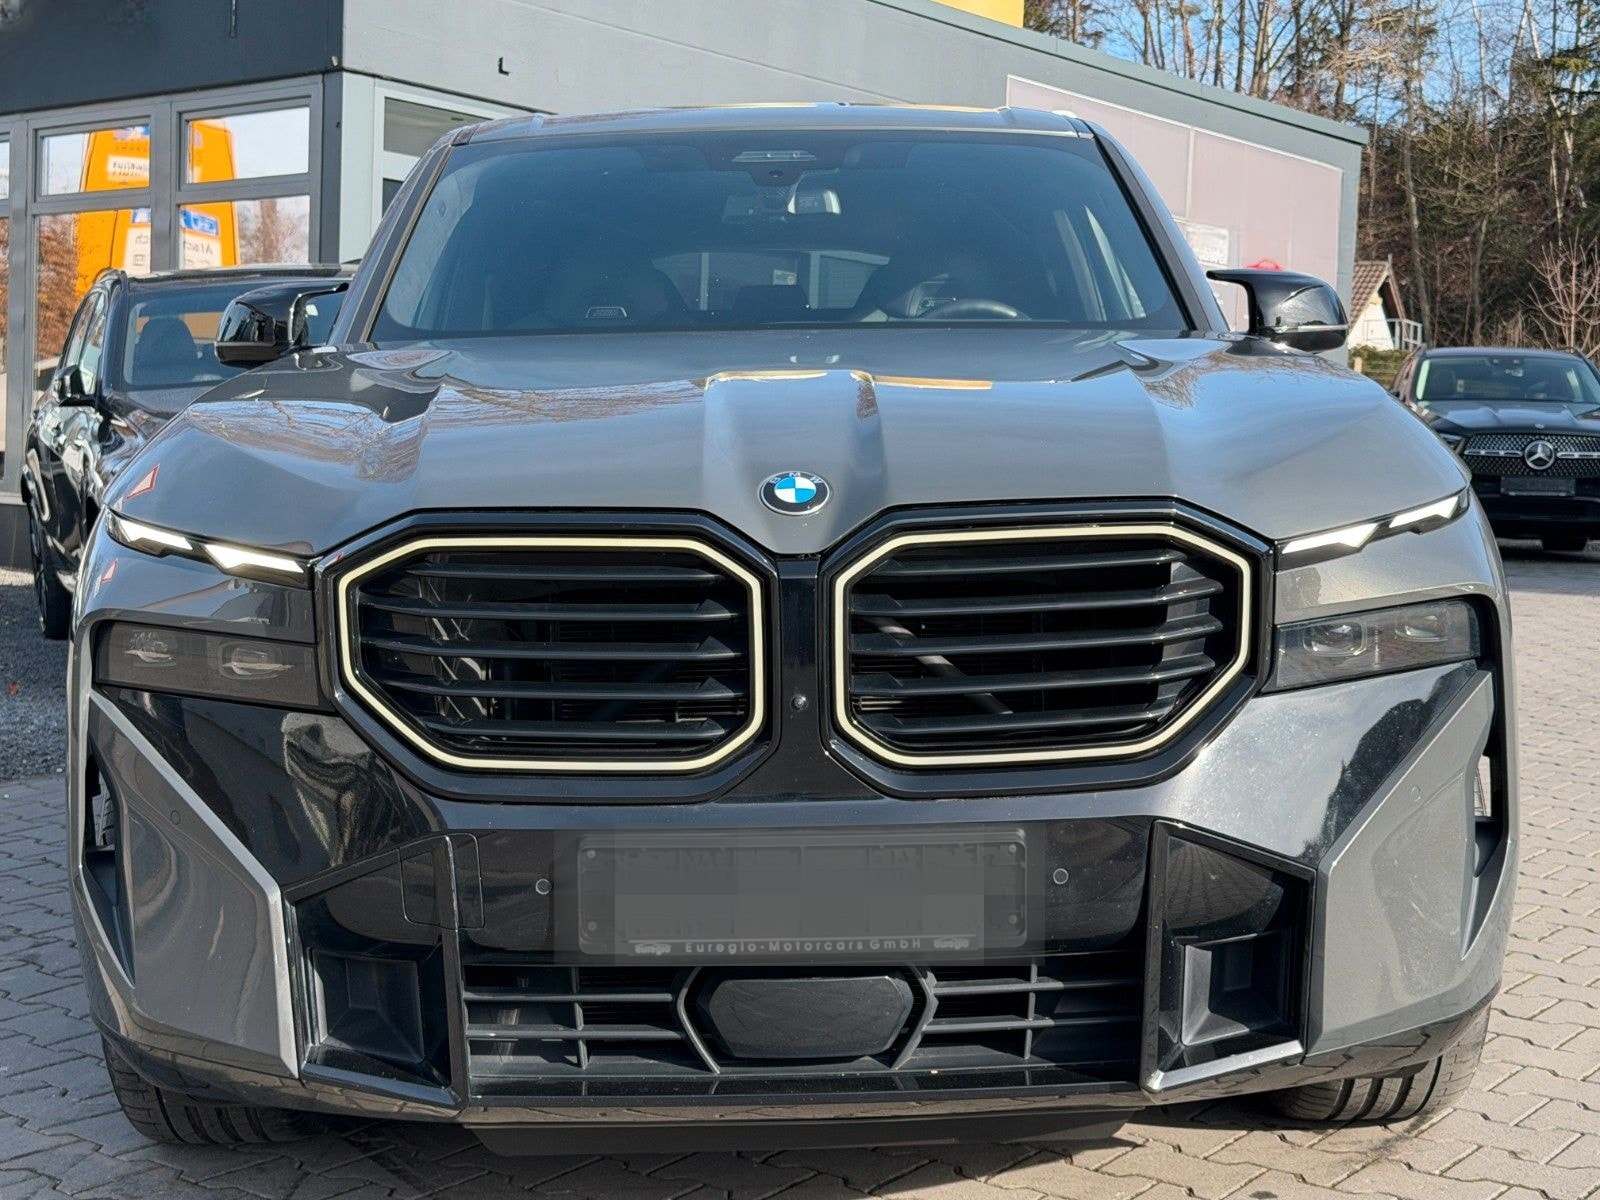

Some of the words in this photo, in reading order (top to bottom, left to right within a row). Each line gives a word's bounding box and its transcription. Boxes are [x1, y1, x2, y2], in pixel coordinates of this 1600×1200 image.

[769, 472, 822, 484] BMW
[685, 940, 863, 954] Euregio-Motorcars
[869, 938, 921, 950] GmbH
